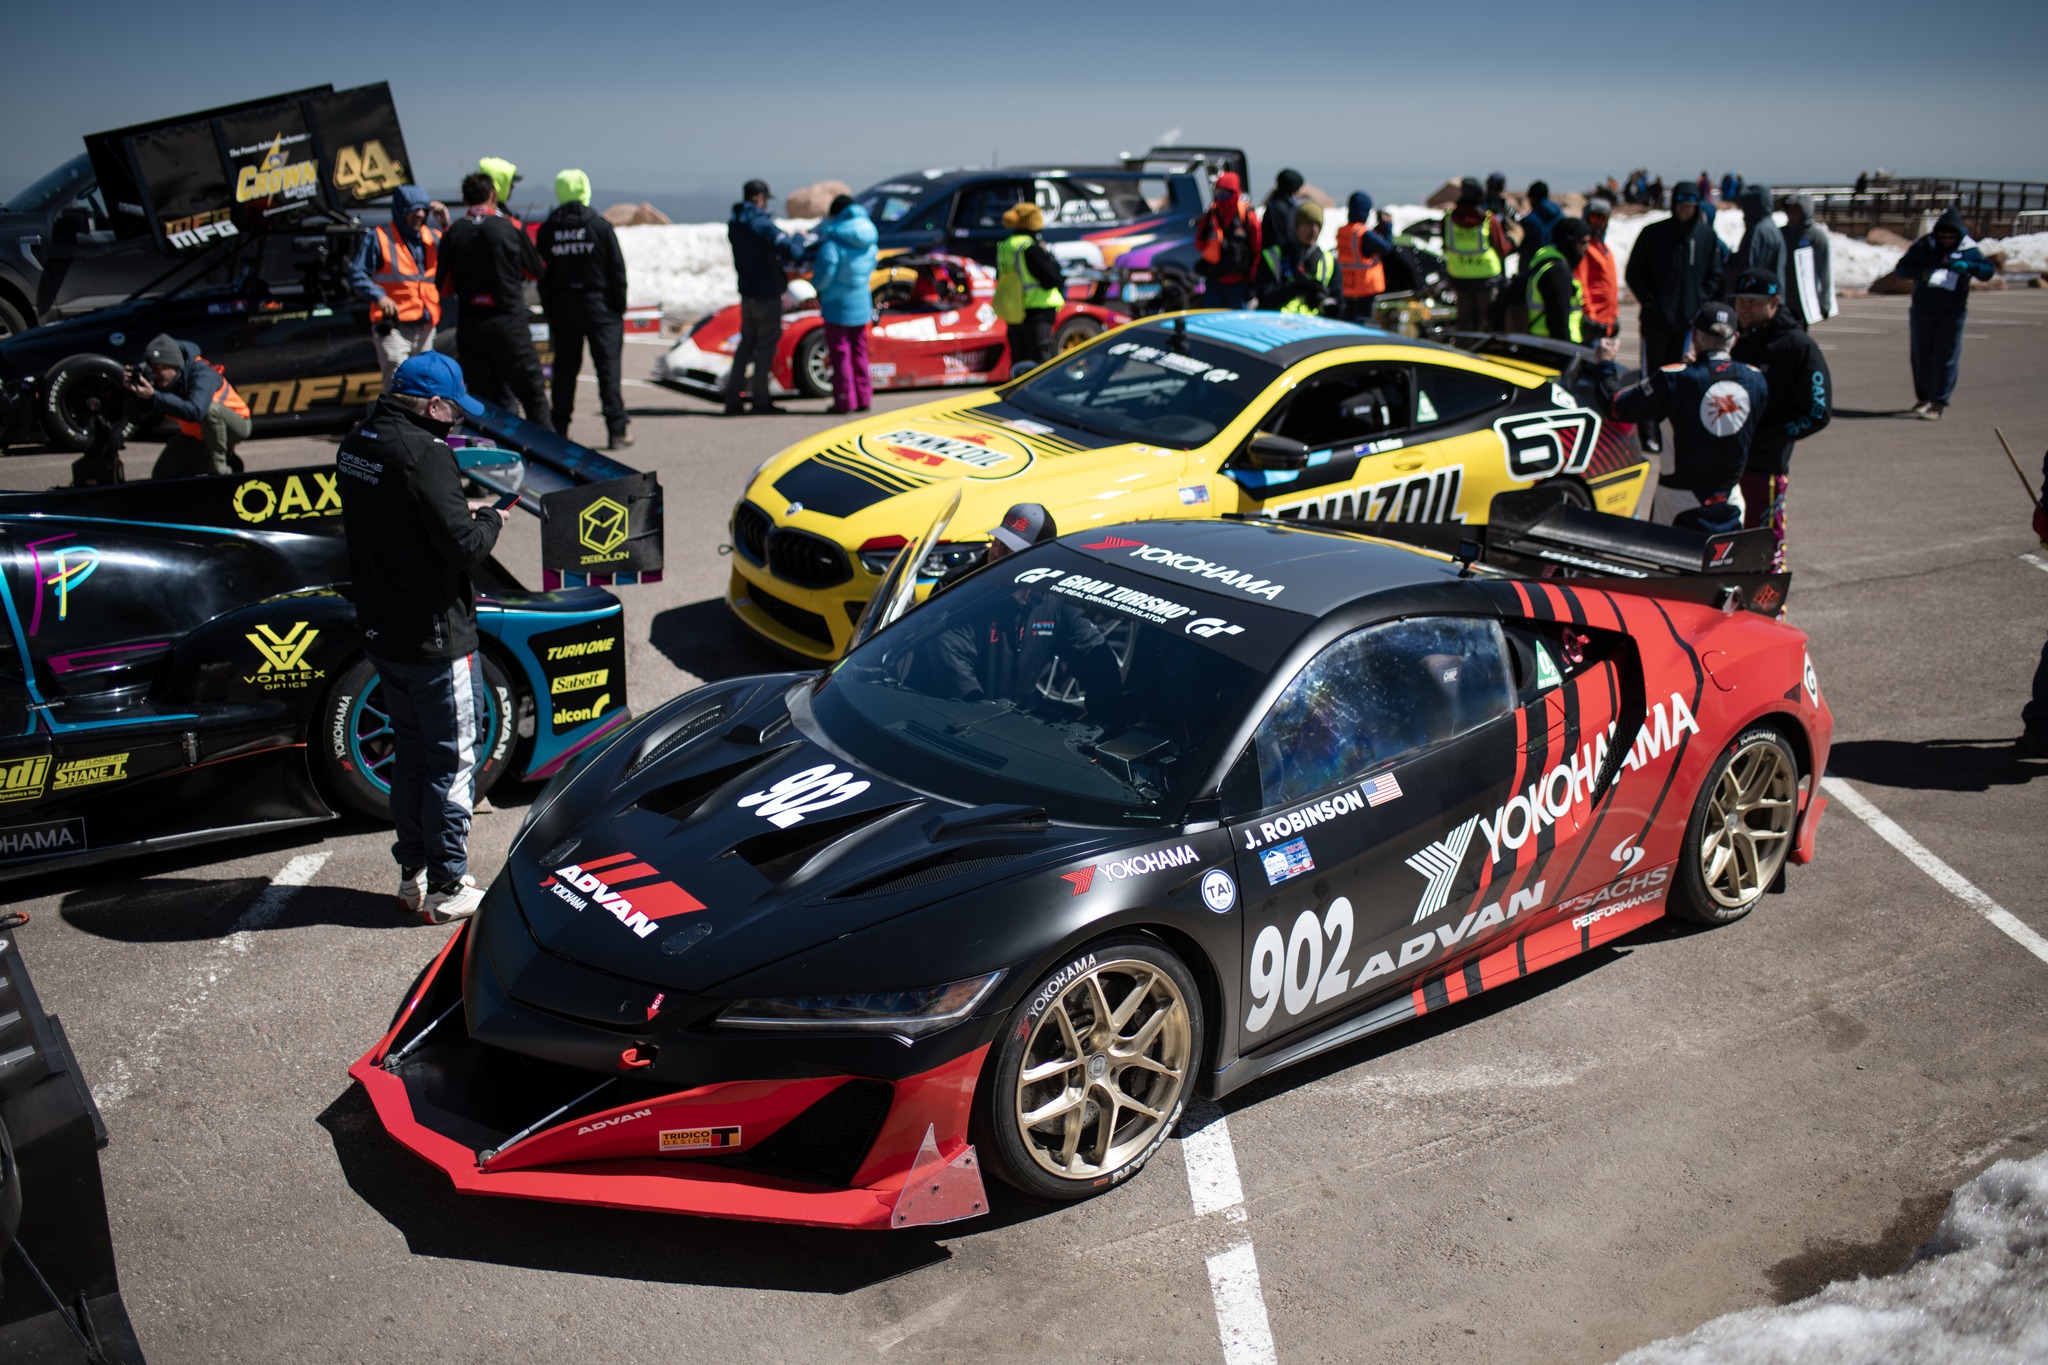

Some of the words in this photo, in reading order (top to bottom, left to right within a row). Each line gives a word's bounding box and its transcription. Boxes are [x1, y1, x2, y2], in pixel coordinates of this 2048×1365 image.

[236, 160, 318, 203] CROWN
[333, 139, 405, 200] 44
[169, 219, 239, 249] MFG
[551, 241, 594, 256] SAFETY
[553, 228, 586, 242] RACE
[1494, 407, 1602, 482] 67
[580, 551, 630, 565] ZEBULON
[1129, 544, 1285, 601] YOKOHAMA
[1058, 574, 1113, 597] GRAN
[1049, 585, 1063, 594] THE
[1063, 588, 1084, 599] REAL
[1084, 593, 1118, 609] DRIVING
[1116, 602, 1167, 624] SIMULATOR
[243, 670, 326, 684] VORTEX
[264, 681, 308, 691] OPTICS
[556, 674, 600, 691] Sabelt
[333, 695, 353, 759] YOKOHAMA
[492, 686, 513, 760] ADVAN
[553, 708, 592, 725] alcon
[1737, 729, 1777, 746] YOKOHAMA
[55, 765, 109, 785] SHANE
[737, 763, 872, 830] 902
[1245, 829, 1262, 850] J.
[1262, 789, 1364, 844] ROBINSON
[0, 827, 76, 854] HAMA
[1097, 844, 1200, 883] YOKOHAMA
[550, 882, 588, 912] YOKOHAMA
[555, 864, 659, 939] ADVAN
[1206, 881, 1232, 899] TAI
[1573, 866, 1669, 912] SACHS
[1572, 887, 1664, 931] PERFORMANCE
[1351, 879, 1547, 990] ADVAN
[1245, 896, 1354, 1033] 902
[1030, 953, 1097, 1018] YOKOHAMA
[651, 993, 663, 1011] TOW
[577, 1108, 652, 1137] ADVAN
[663, 1130, 711, 1141] TRIDICO
[663, 1137, 710, 1146] DESIGN
